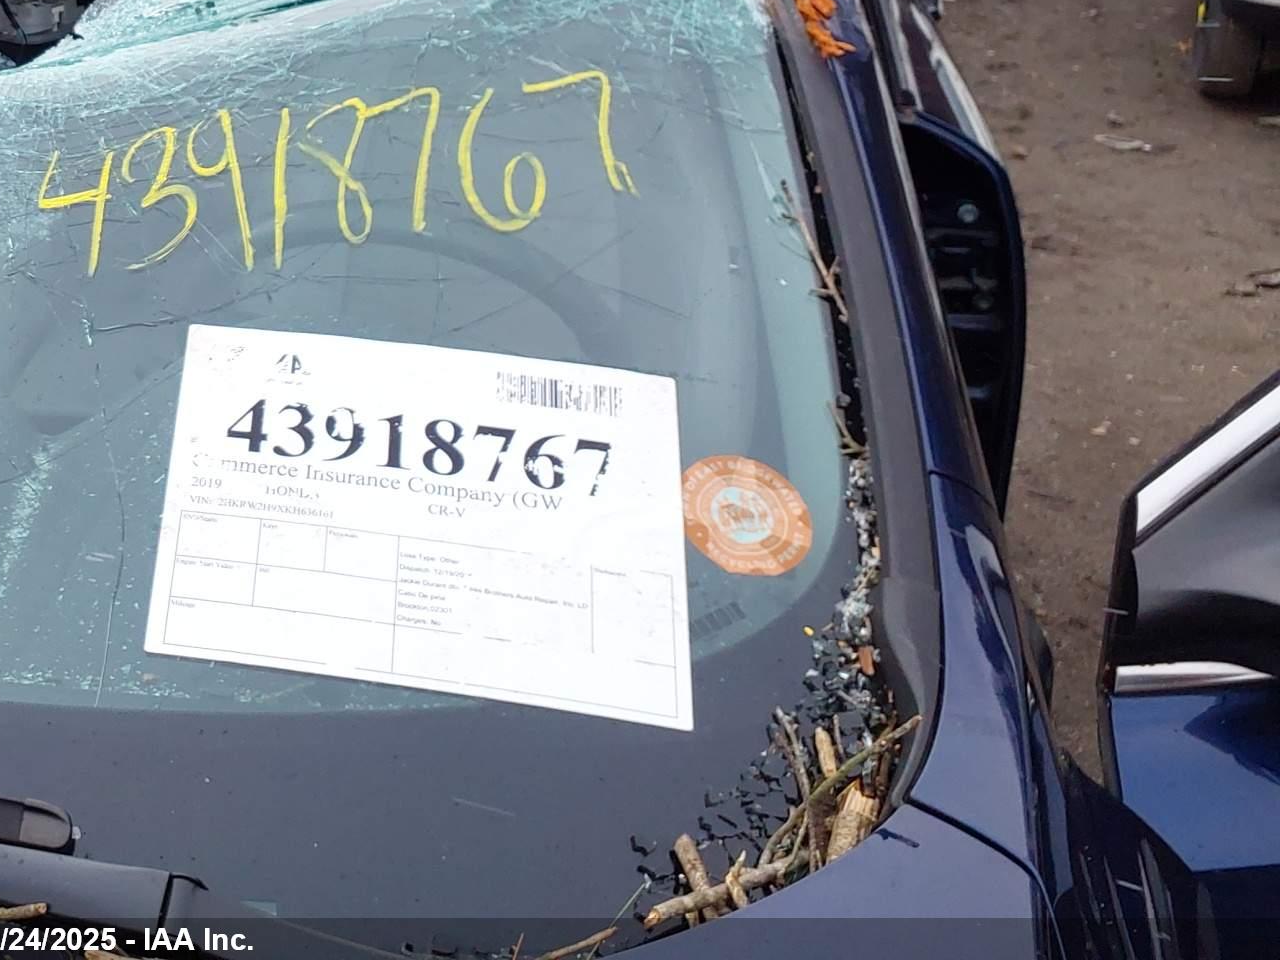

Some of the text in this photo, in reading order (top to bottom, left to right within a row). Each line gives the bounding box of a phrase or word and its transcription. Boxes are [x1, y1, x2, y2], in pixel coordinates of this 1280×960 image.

[37, 70, 640, 276] 43918767
[226, 398, 613, 497] 43918767
[191, 476, 222, 489] 2019
[305, 465, 401, 492] Insurance
[407, 476, 507, 511] Company
[512, 488, 564, 512] (GW
[428, 503, 466, 519] CR-V
